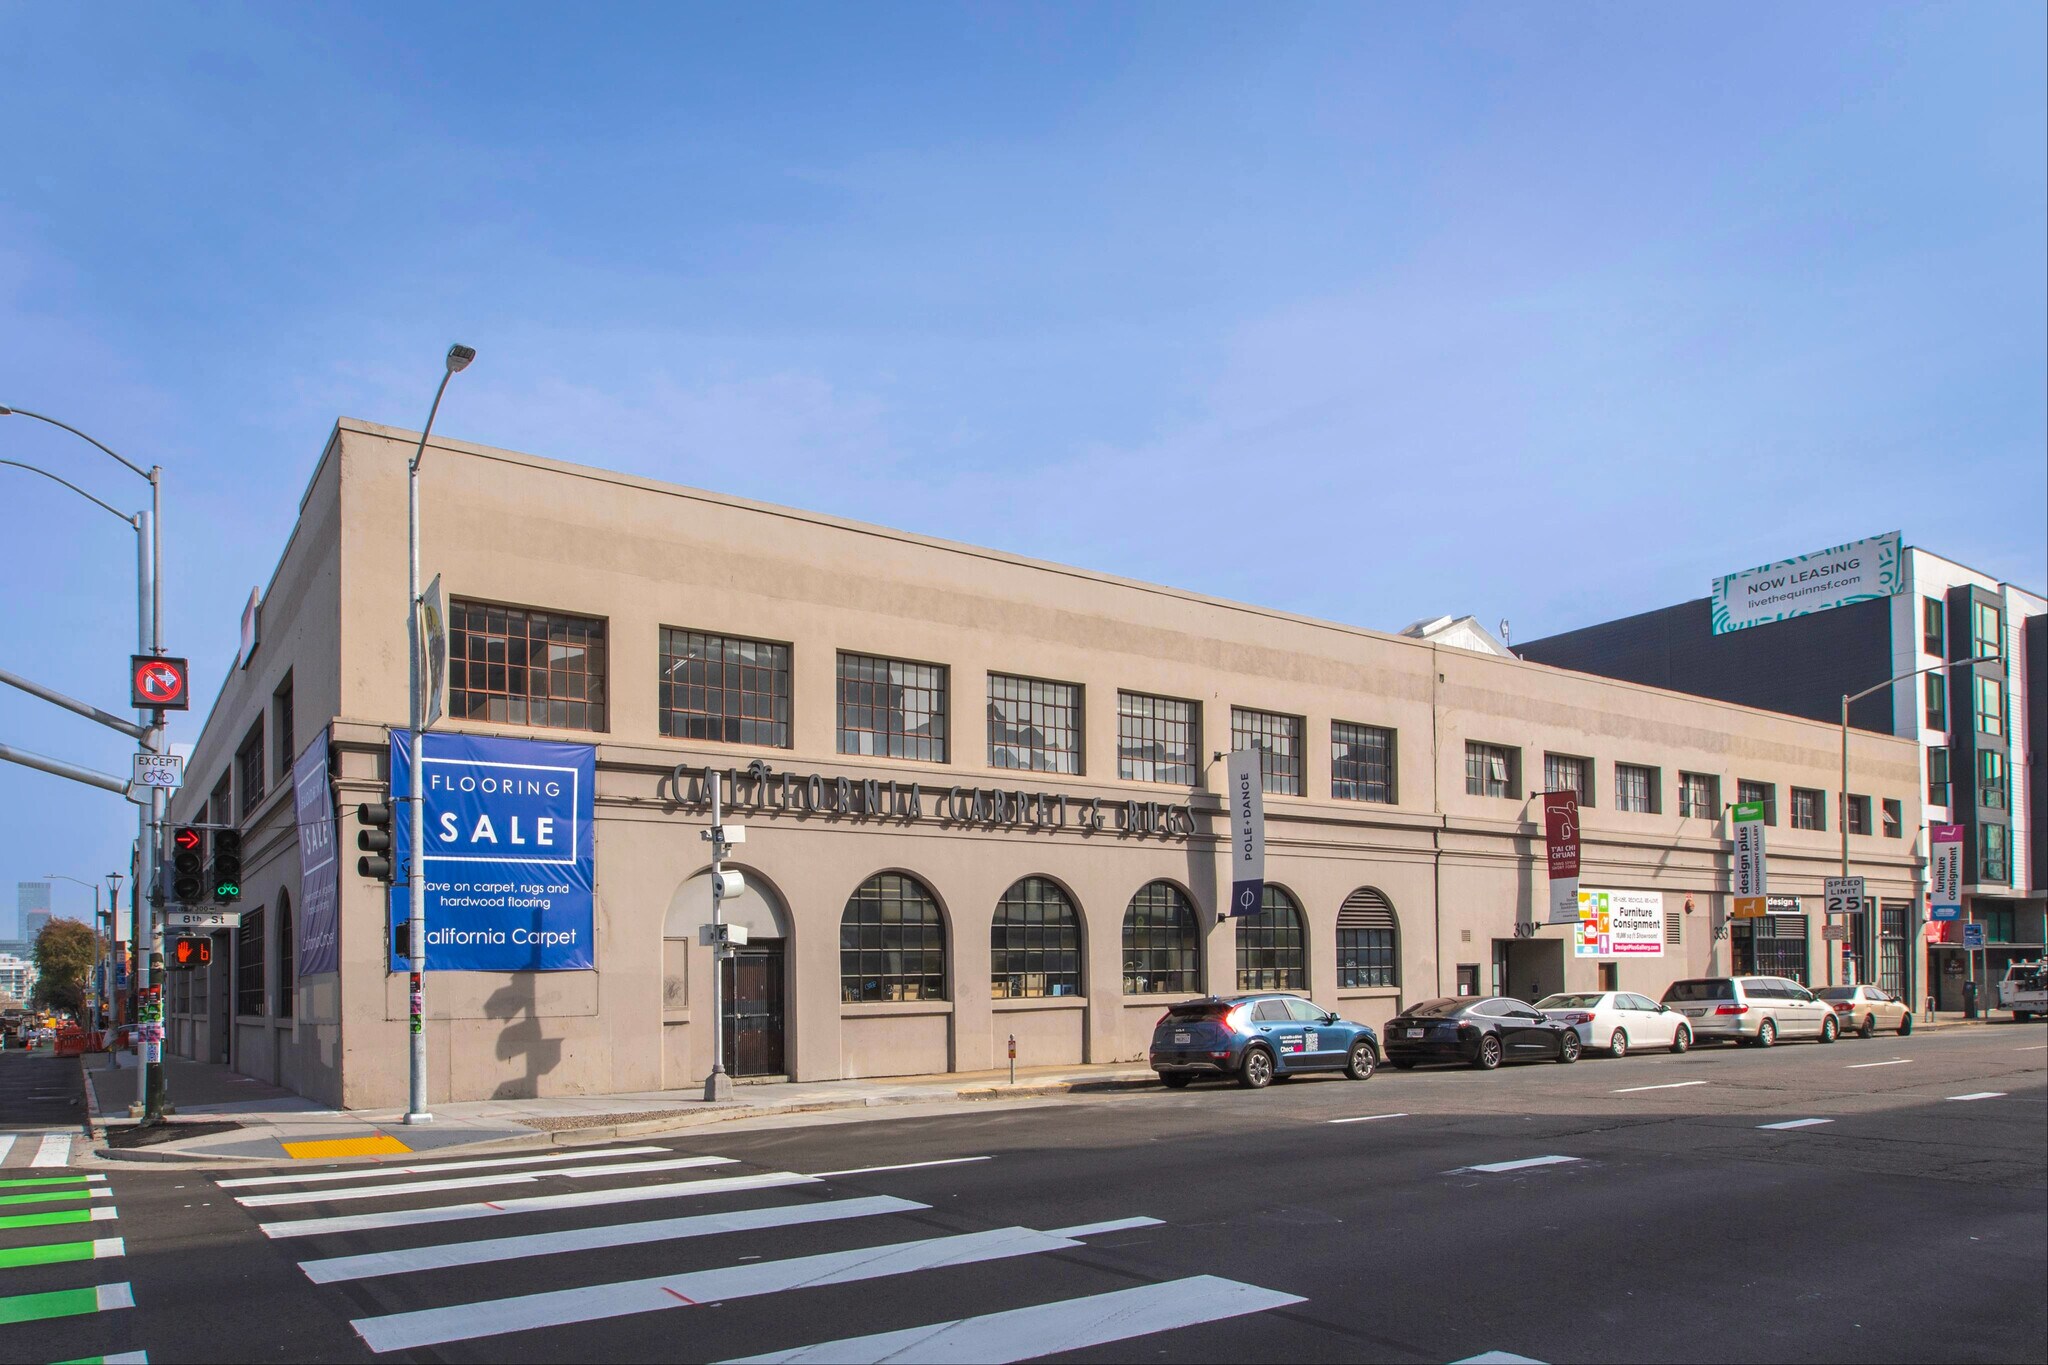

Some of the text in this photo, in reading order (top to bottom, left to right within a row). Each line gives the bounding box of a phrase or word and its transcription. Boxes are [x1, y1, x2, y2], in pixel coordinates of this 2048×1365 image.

[1748, 558, 1861, 595] NOW LEASING
[1748, 575, 1861, 608] livethequinnsf.com
[139, 757, 178, 767] EXCEPT
[432, 775, 560, 797] FLOORING
[1241, 773, 1251, 818] DANCE
[949, 786, 1069, 827] CARPET
[1091, 797, 1105, 830] &
[1127, 800, 1197, 835] RUGS
[305, 816, 328, 855] SALE
[439, 812, 553, 846] SALE
[1244, 827, 1253, 861] POLE
[1738, 826, 1751, 894] design plus
[1936, 856, 1945, 893] furniture
[1948, 847, 1958, 900] consignment
[454, 883, 470, 892] on
[473, 882, 517, 894] carpet,
[520, 884, 544, 895] rugs
[546, 883, 569, 894] and
[440, 895, 551, 910] hardwood flooring
[1620, 907, 1652, 917] Furniture
[1768, 897, 1793, 906] design
[1828, 897, 1860, 911] 25
[183, 915, 224, 924] 8th St
[1514, 922, 1534, 937] 301
[1613, 918, 1660, 930] Consignment
[423, 928, 576, 948] alifornia Carpet
[1714, 927, 1728, 940] 333
